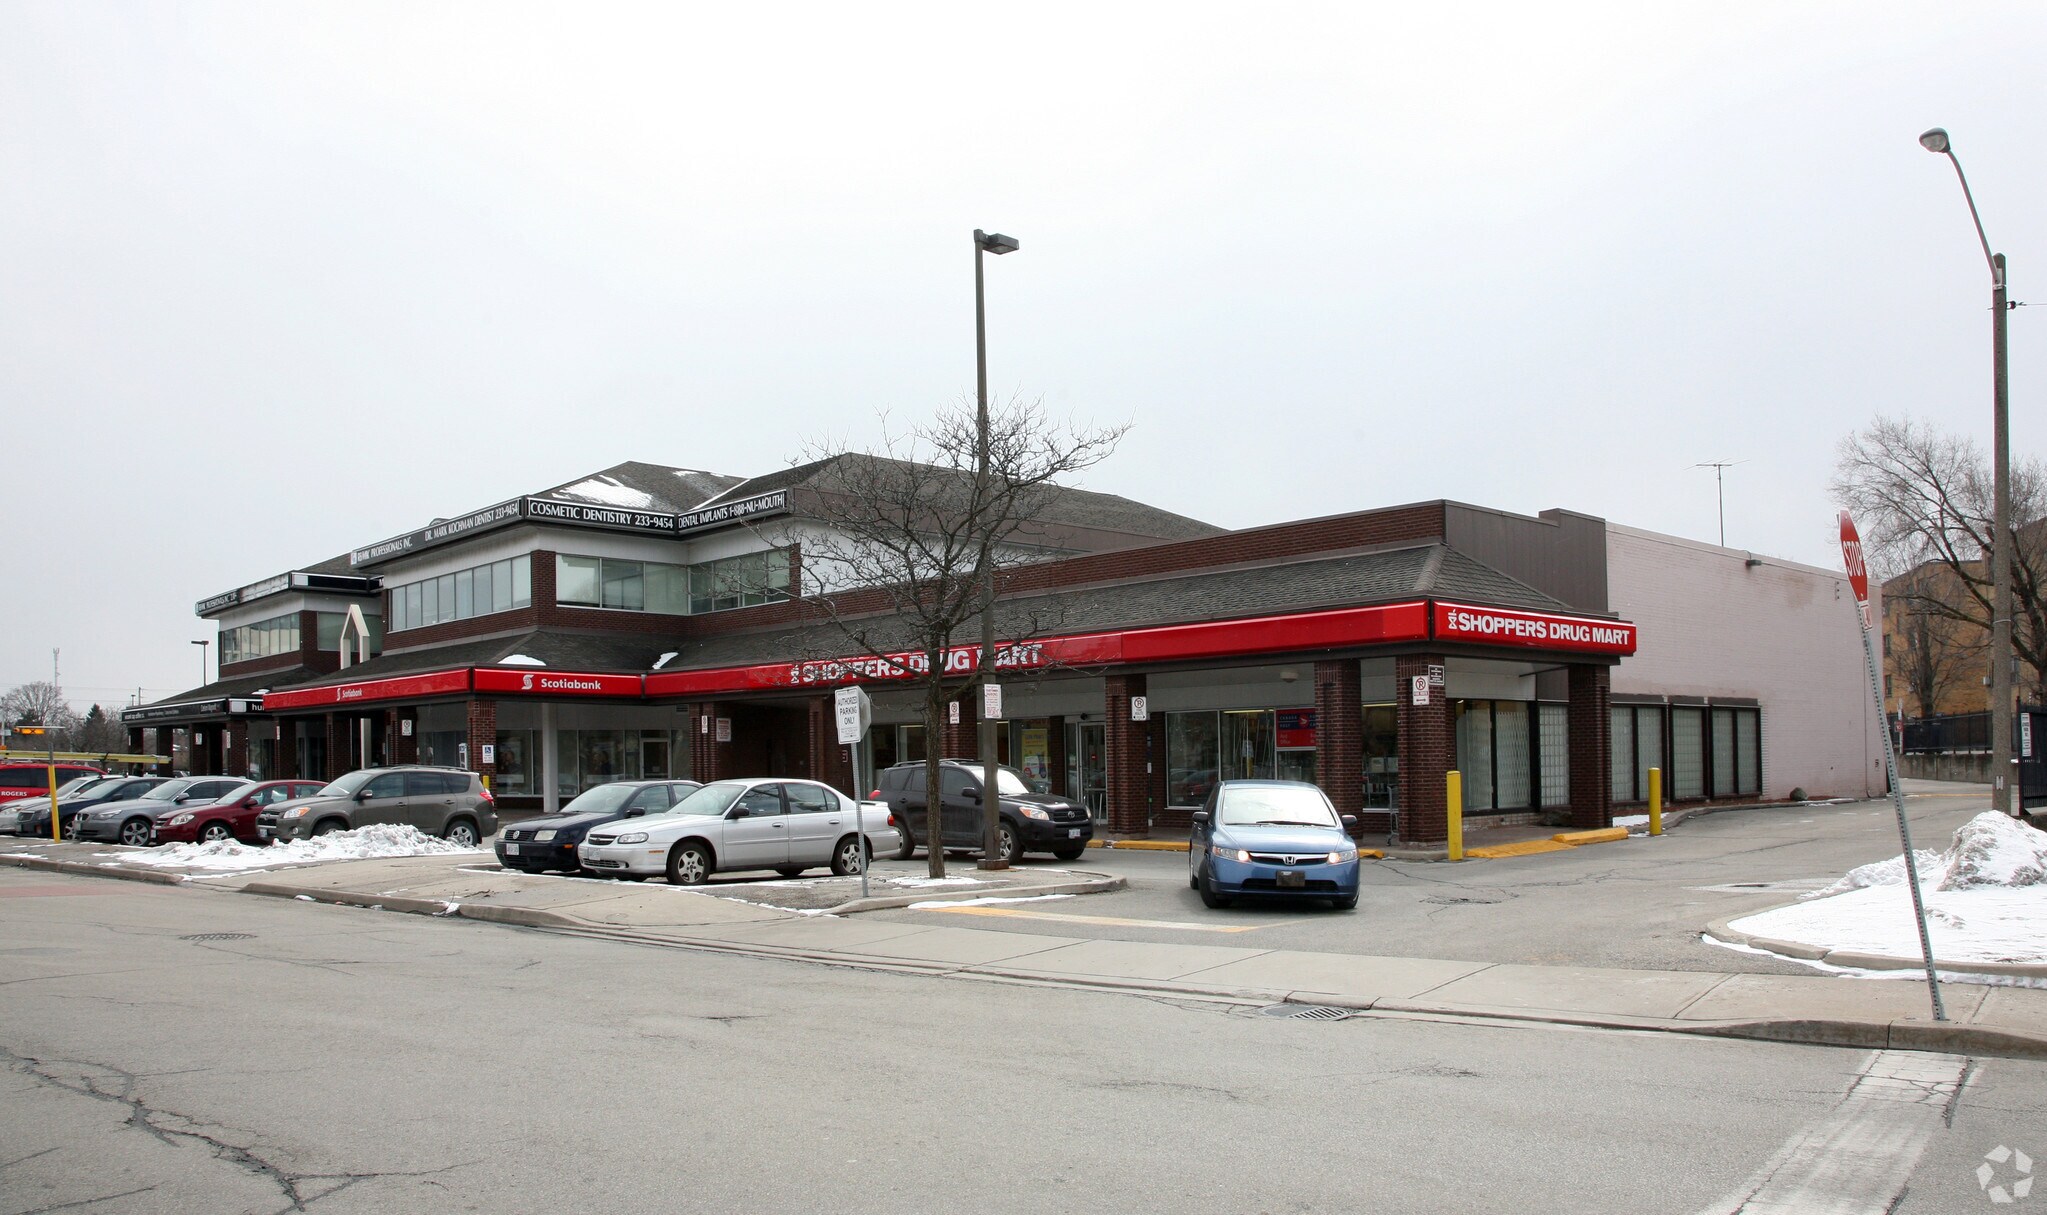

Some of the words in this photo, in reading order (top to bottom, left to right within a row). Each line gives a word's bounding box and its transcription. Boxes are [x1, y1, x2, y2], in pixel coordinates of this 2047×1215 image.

[425, 531, 433, 542] DR.
[434, 526, 448, 538] MARK
[475, 511, 493, 527] DENTIST
[496, 503, 518, 519] 233-9454
[531, 502, 580, 519] COSMETIC
[583, 508, 632, 524] DENTISTRY
[635, 515, 674, 529] 233-9454
[679, 514, 699, 528] DENTAL
[700, 507, 728, 523] IMPLANTS
[729, 495, 783, 517] 1-888-NU-MOUTH
[371, 541, 402, 558] PROFESSIONALS
[1843, 541, 1863, 577] STOP
[1457, 612, 1547, 639] SHOPPERS
[1550, 622, 1590, 642] DRUG
[1592, 627, 1630, 645] MART
[342, 688, 363, 698] Scotiabank
[541, 678, 601, 690] Scotiabank
[839, 706, 857, 716] PARKING
[843, 716, 855, 725] ONLY
